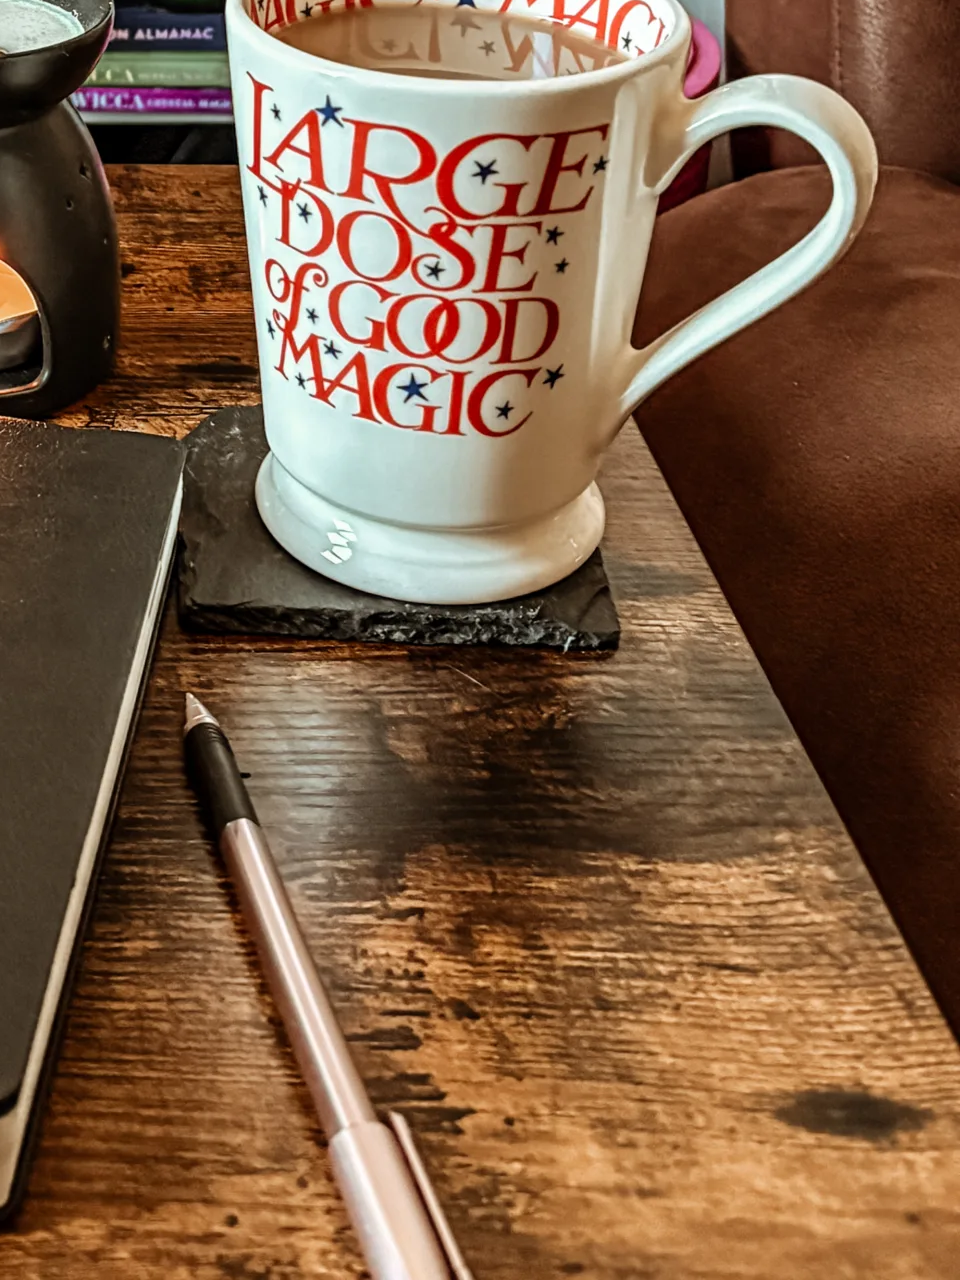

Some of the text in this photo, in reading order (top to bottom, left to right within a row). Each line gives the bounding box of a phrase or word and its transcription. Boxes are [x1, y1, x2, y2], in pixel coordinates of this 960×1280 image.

[134, 27, 213, 40] ALMANAC
[71, 91, 144, 111] WICCA
[246, 71, 611, 230] LARGE
[275, 178, 544, 294] DOSE
[328, 279, 560, 365] GOOD
[273, 312, 544, 438] MAGIC
